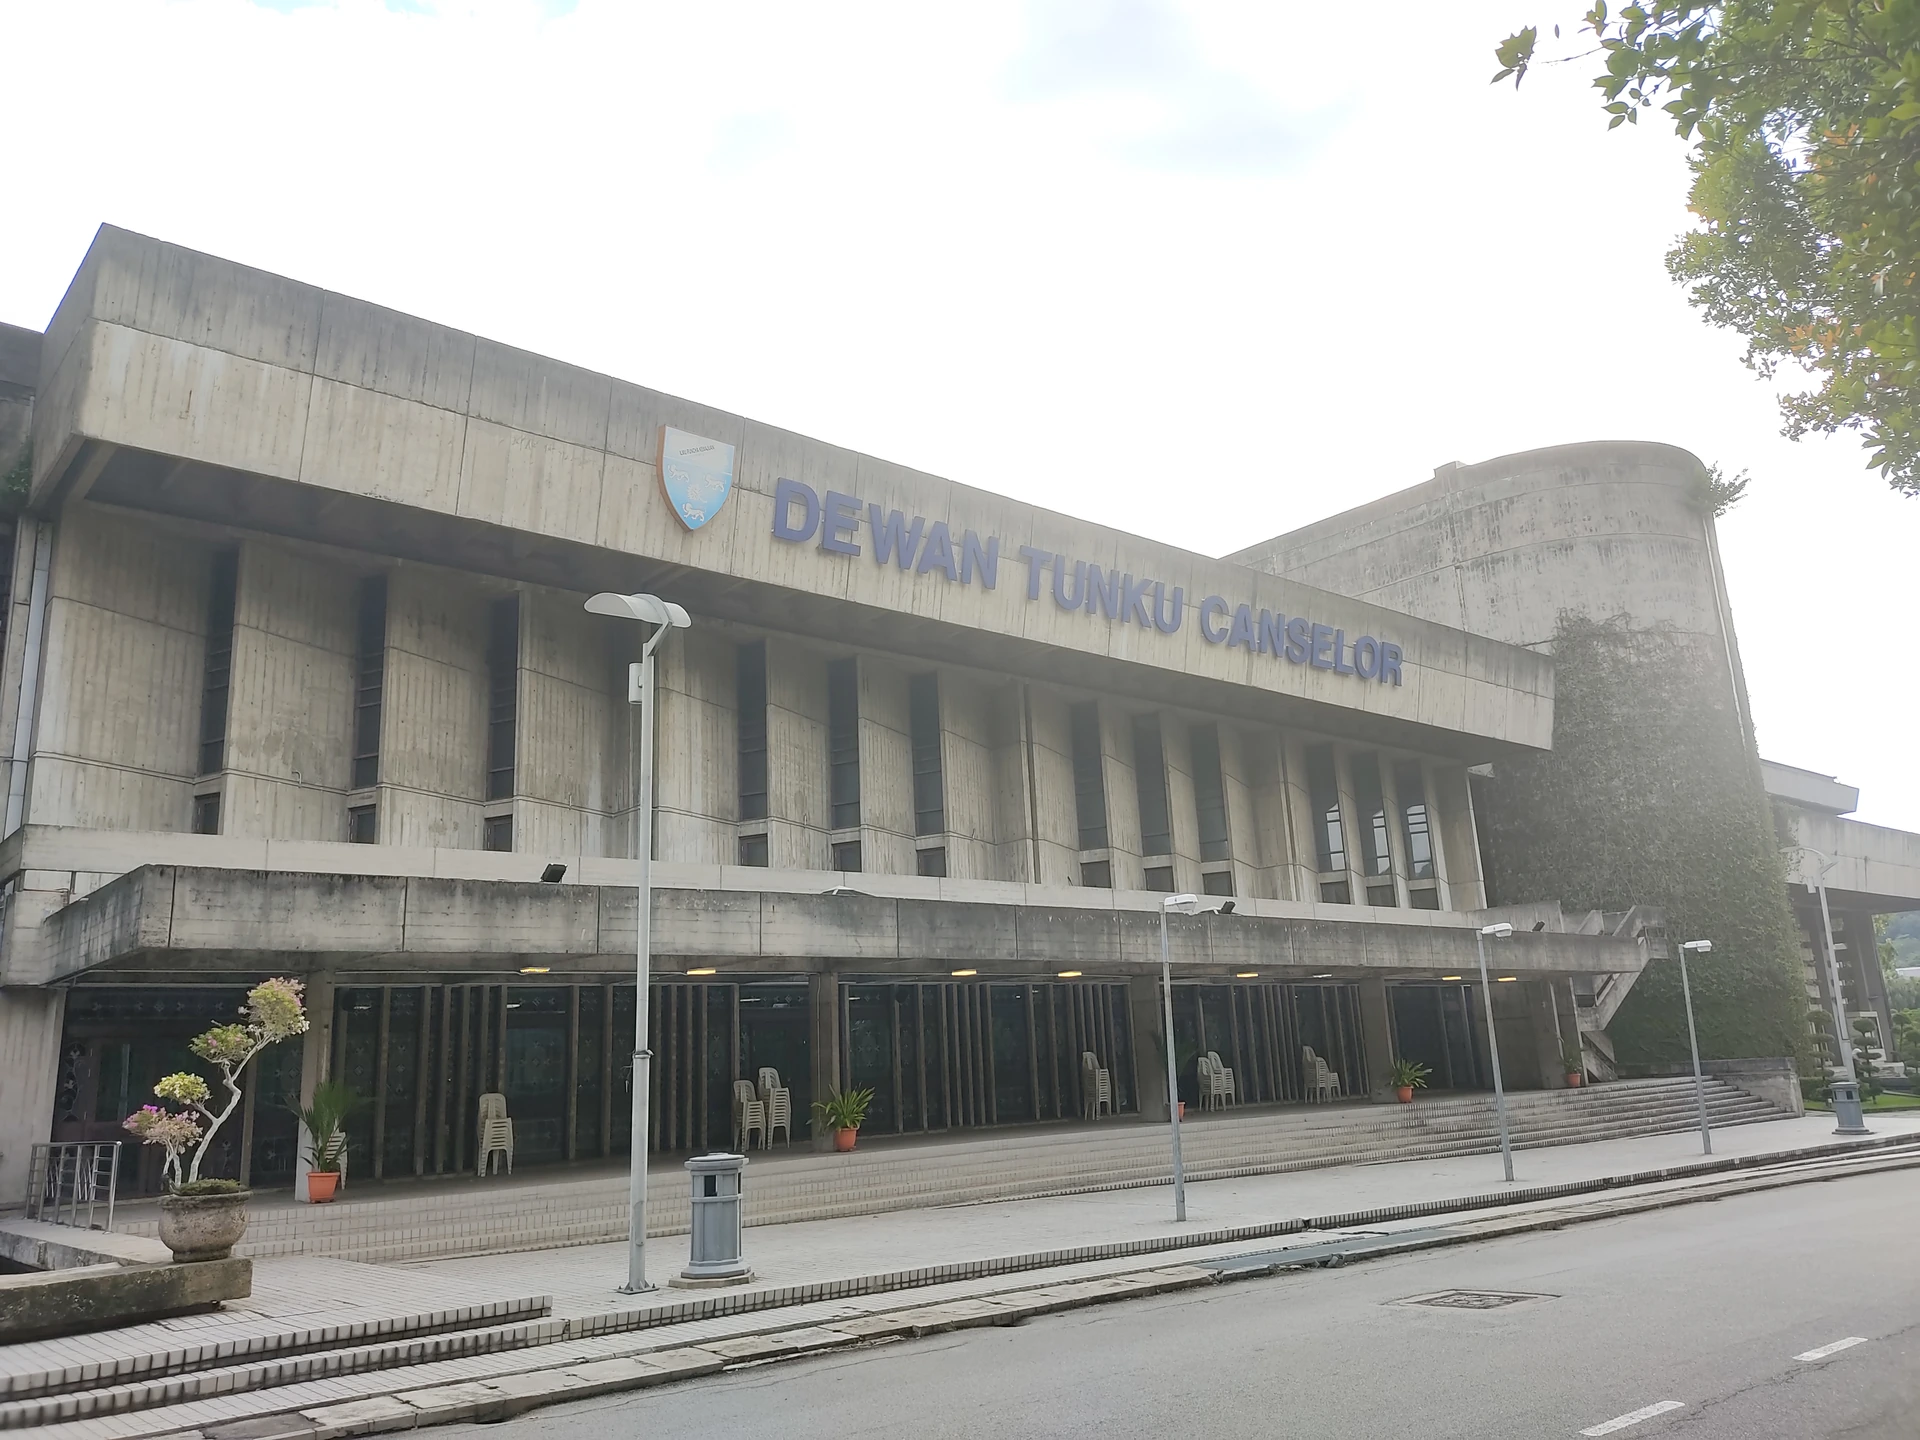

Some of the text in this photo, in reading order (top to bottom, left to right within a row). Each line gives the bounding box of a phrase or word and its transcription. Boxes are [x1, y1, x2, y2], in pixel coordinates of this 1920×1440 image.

[773, 477, 1403, 686] DEWAN TUNKU CANSELOR
